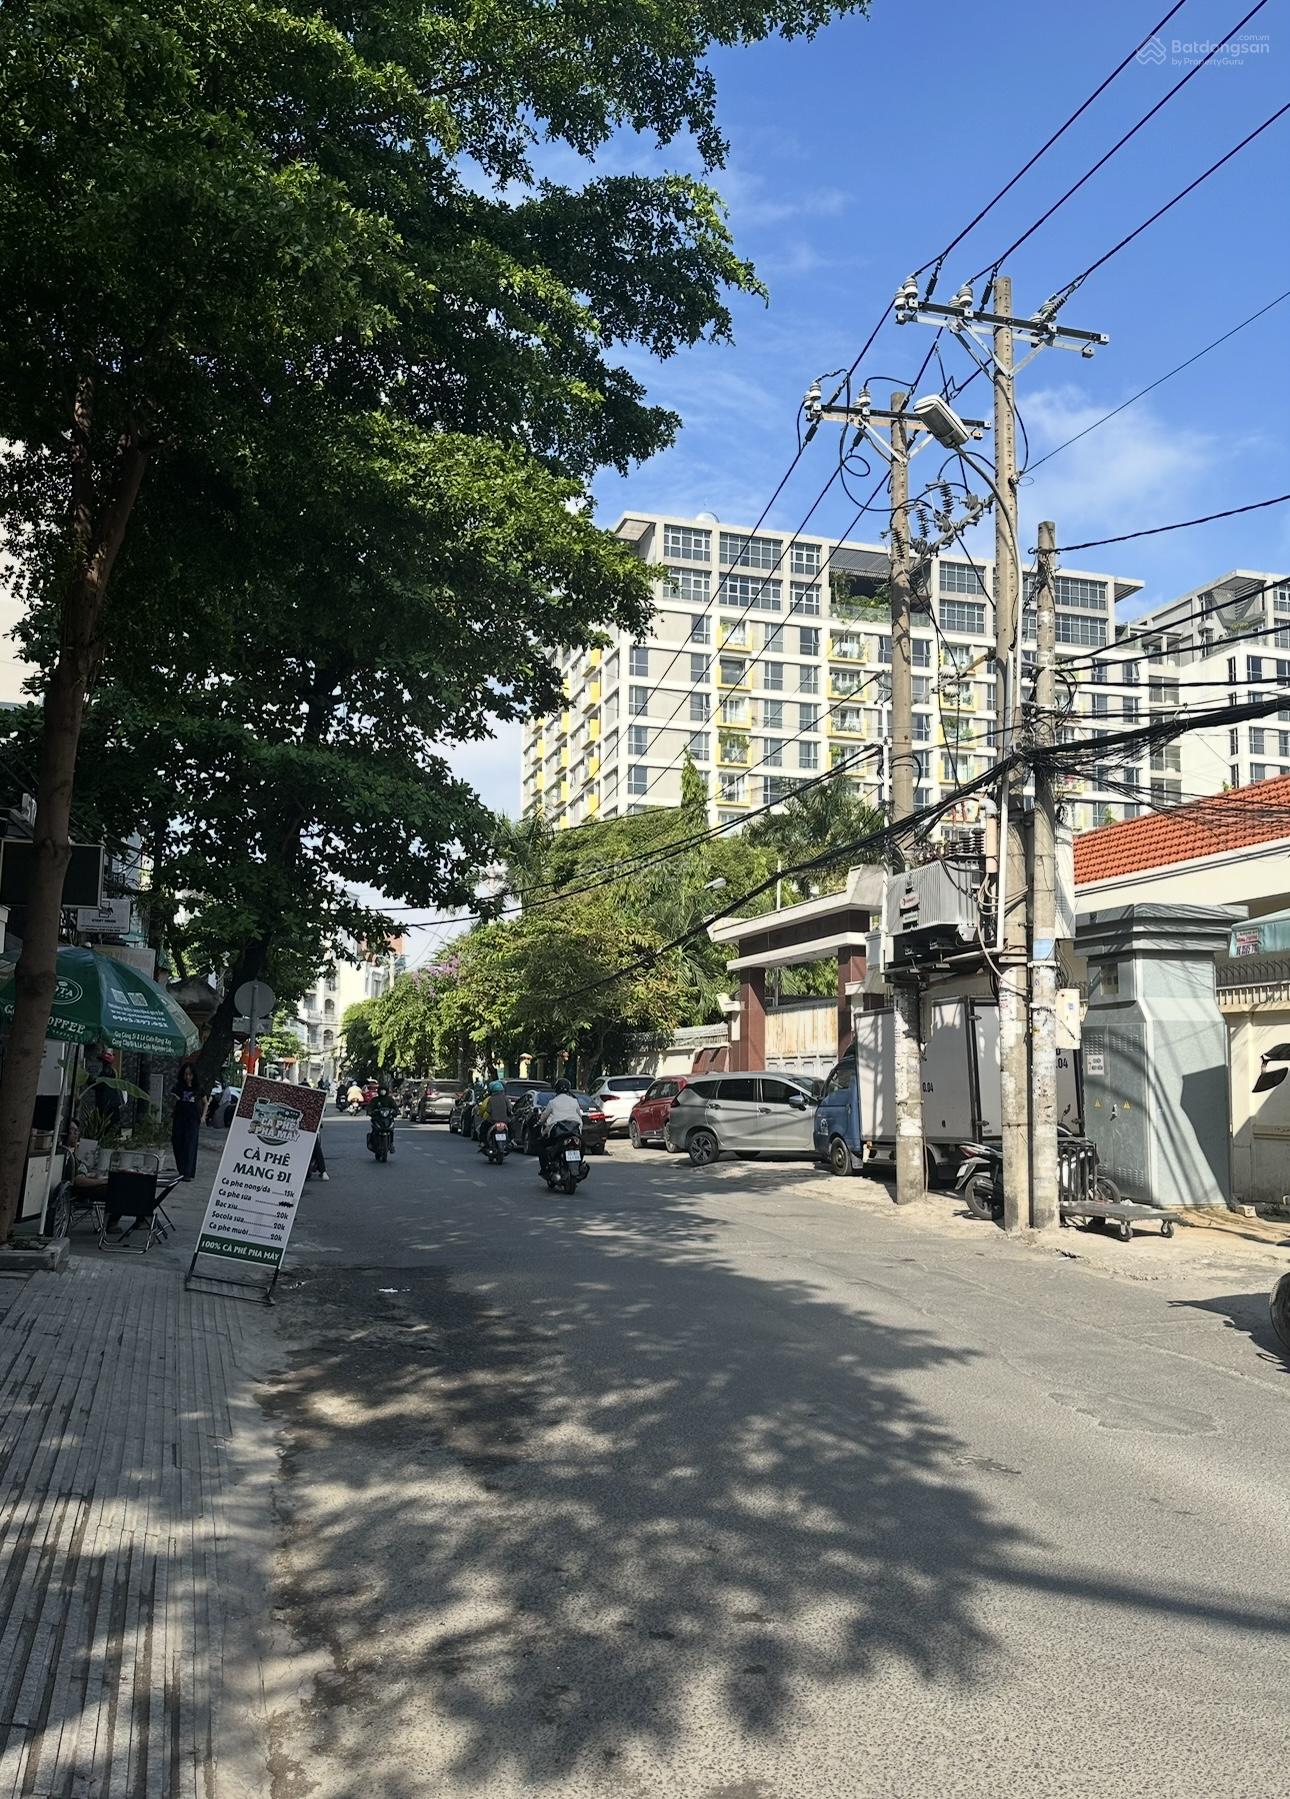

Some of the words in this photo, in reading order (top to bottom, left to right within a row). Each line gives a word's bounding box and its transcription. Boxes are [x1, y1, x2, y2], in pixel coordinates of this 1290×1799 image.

[48, 1016, 86, 1034] OFFEE
[243, 1147, 261, 1161] CÀ
[263, 1152, 291, 1167] PHÊ
[232, 1162, 275, 1180] MANG
[277, 1171, 292, 1184] ĐI
[201, 1240, 221, 1250] 100%
[248, 1248, 263, 1258] PHA
